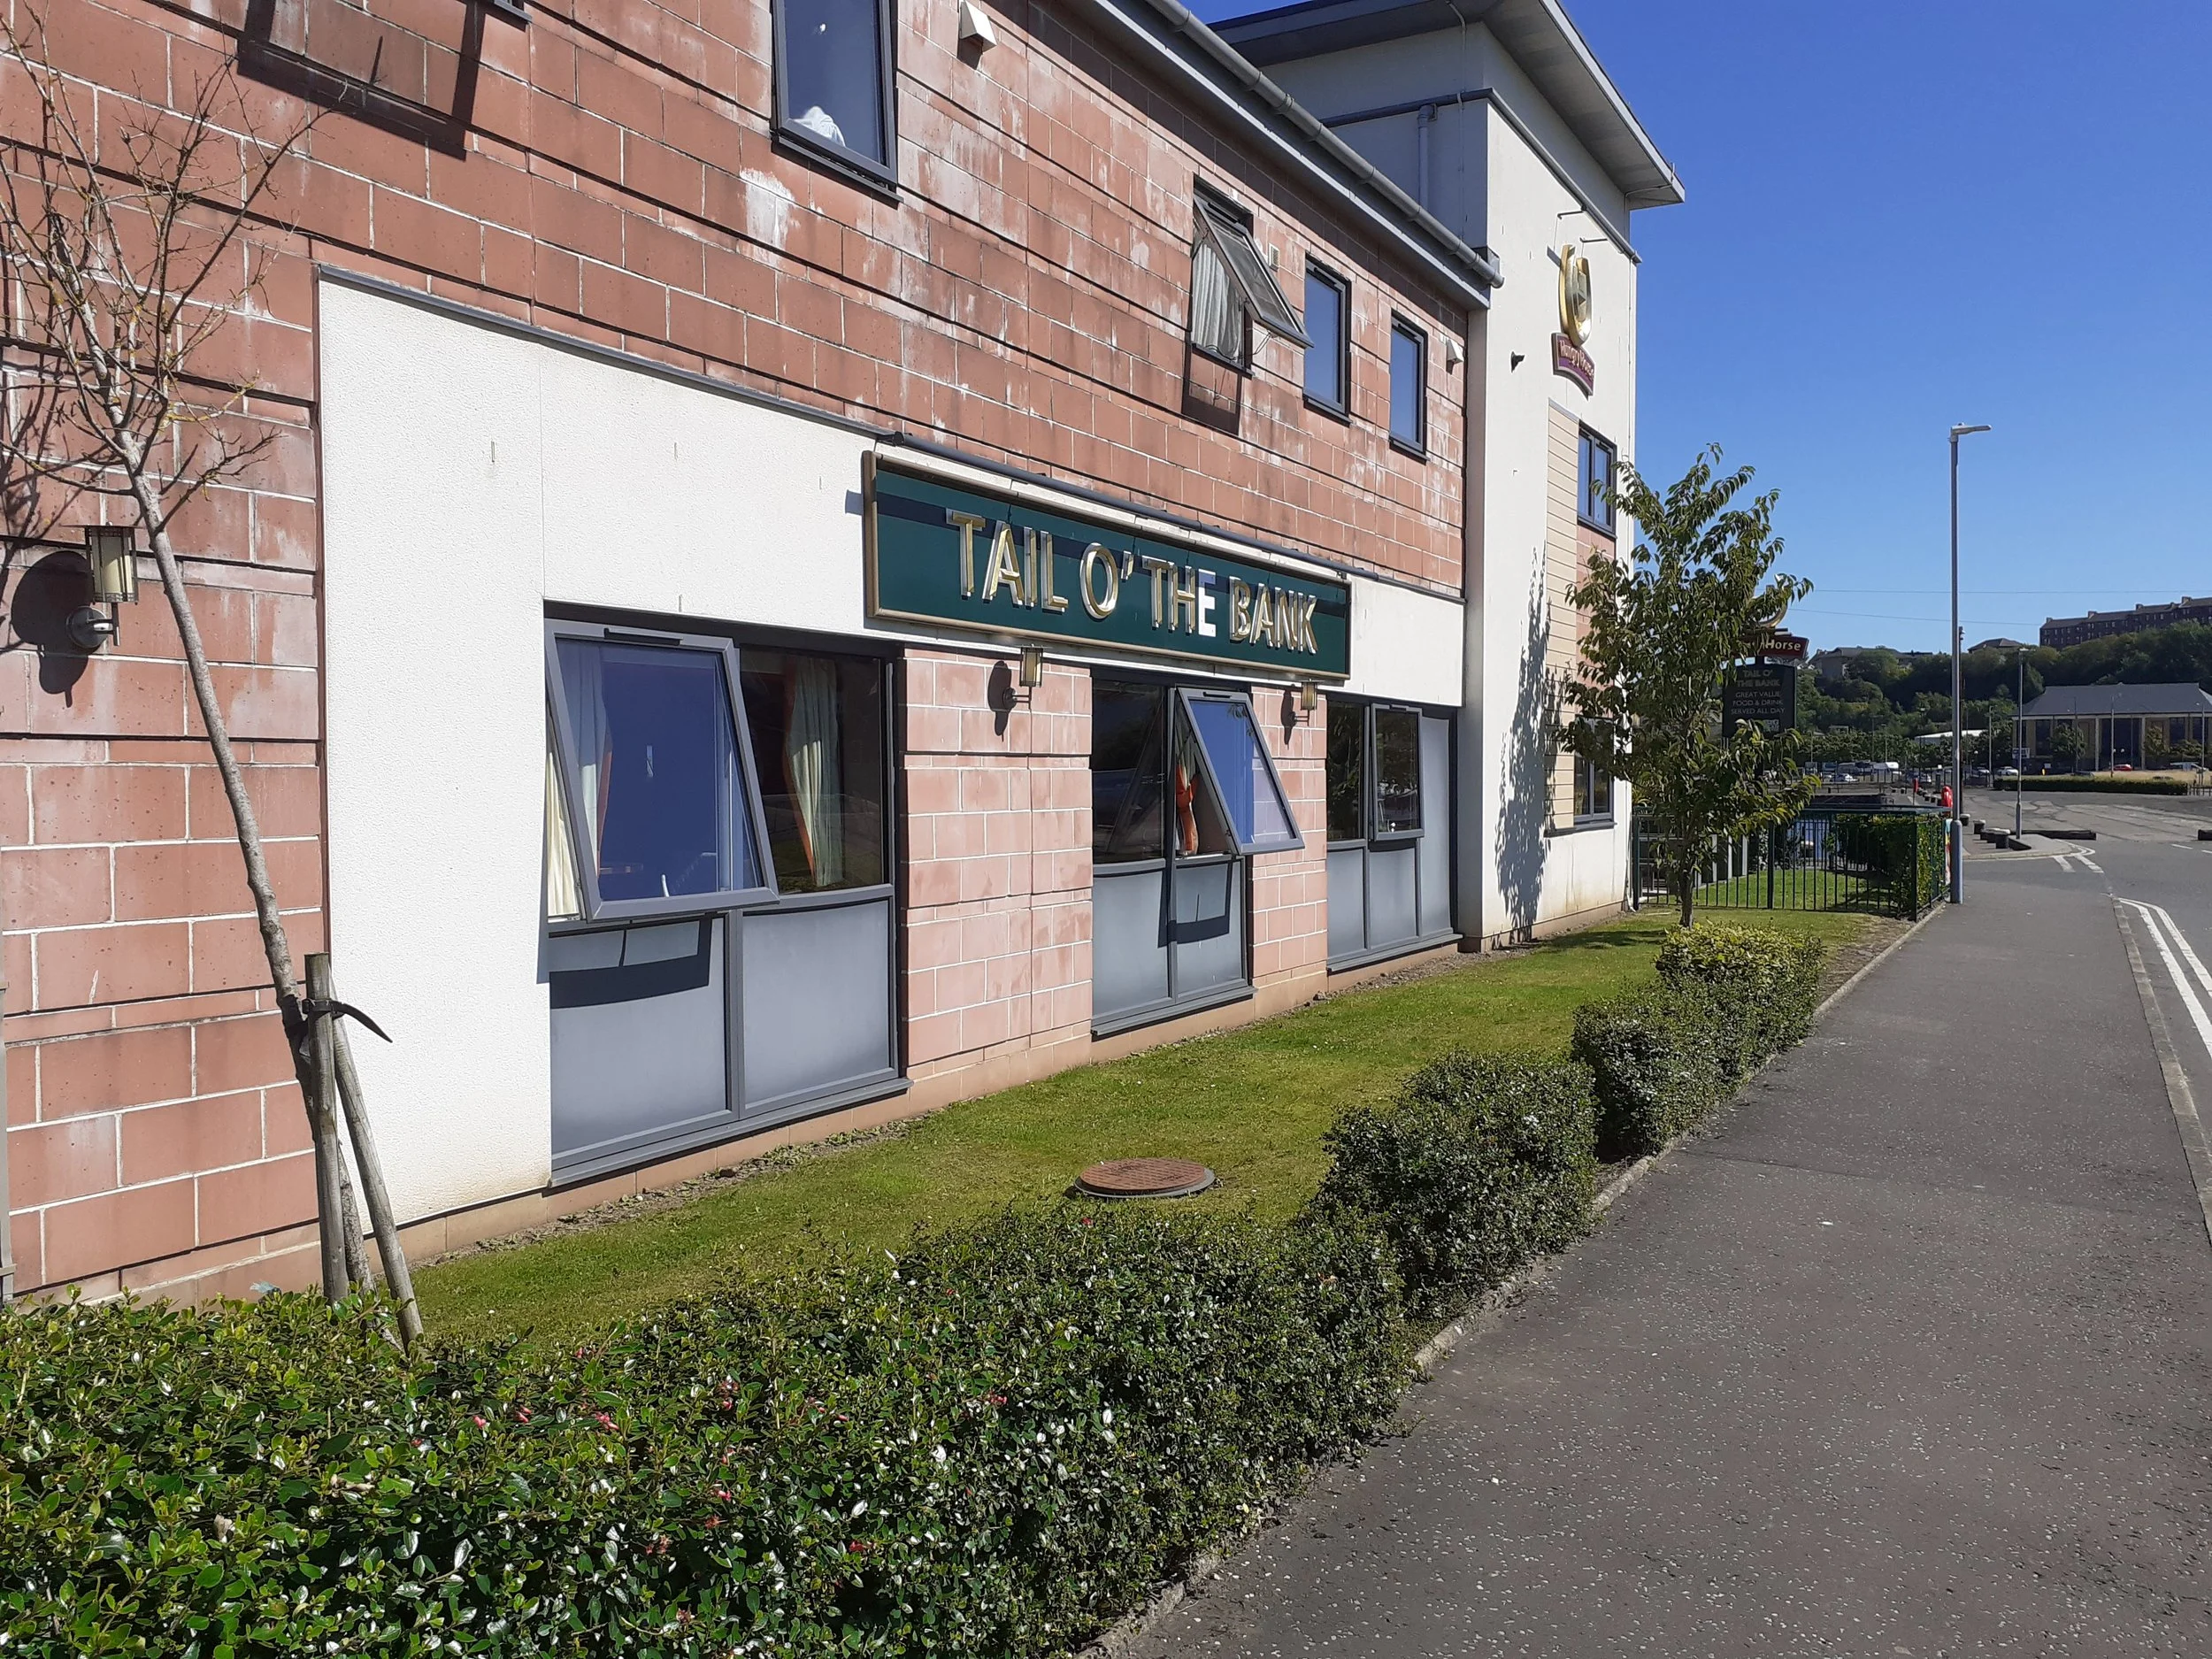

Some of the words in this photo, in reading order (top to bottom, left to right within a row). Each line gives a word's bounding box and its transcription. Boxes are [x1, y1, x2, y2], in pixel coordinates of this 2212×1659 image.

[945, 508, 1068, 613] TAIL
[1078, 541, 1134, 618] O'
[1141, 555, 1217, 637] THE
[1229, 575, 1319, 655] BANK
[1765, 638, 1801, 651] Horse
